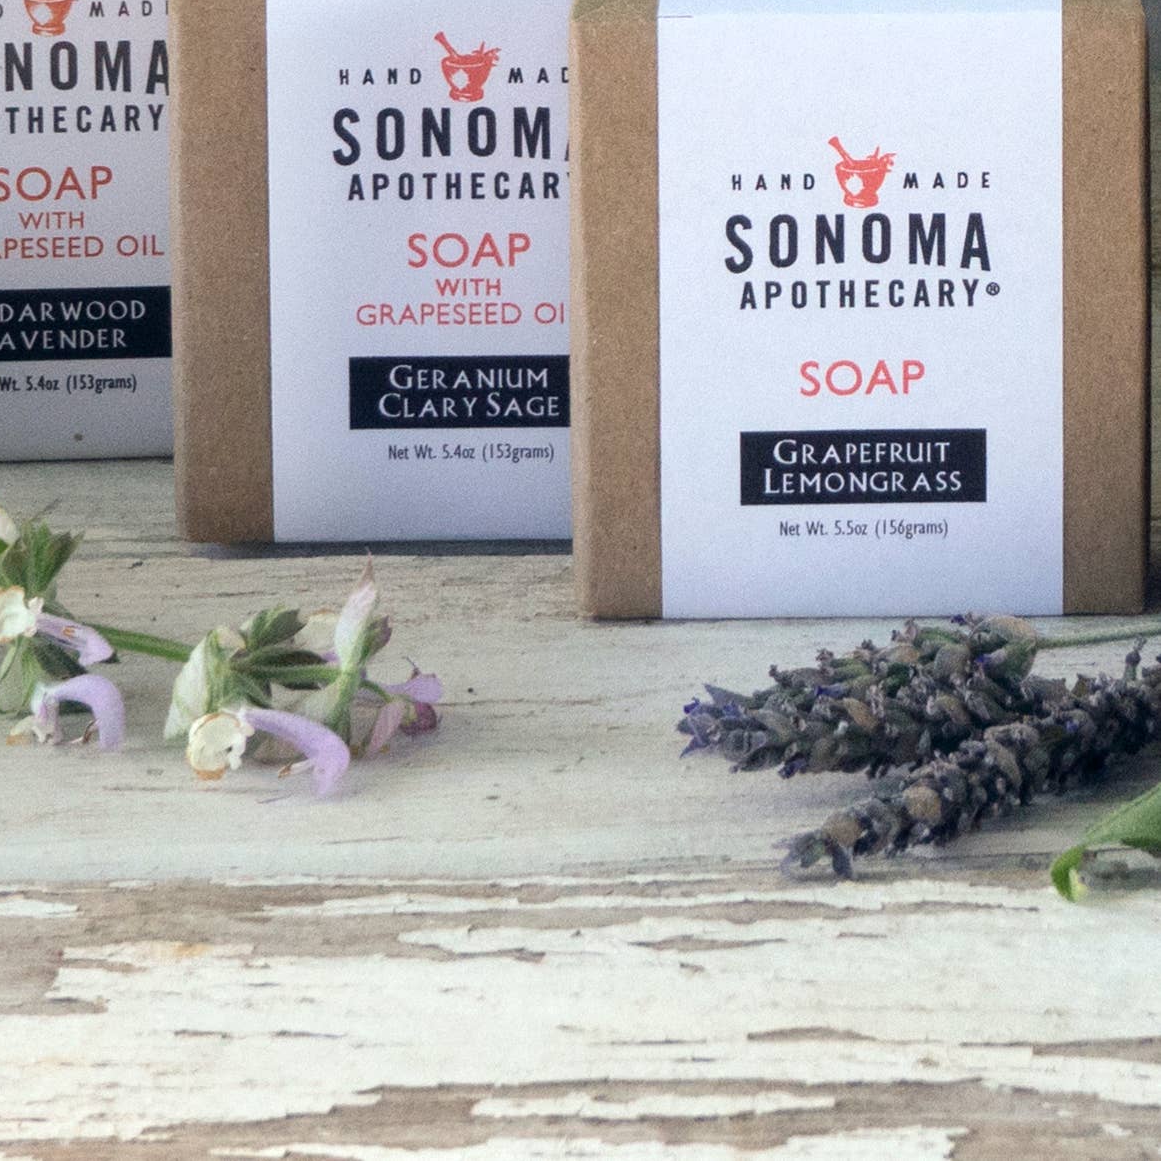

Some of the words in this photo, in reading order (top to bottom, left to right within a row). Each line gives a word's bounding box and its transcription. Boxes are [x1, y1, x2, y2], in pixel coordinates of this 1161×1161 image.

[339, 68, 422, 85] HAND
[508, 67, 569, 84] MAD
[332, 107, 569, 166] SONOM
[348, 172, 569, 200] APOTHECAR
[731, 174, 815, 190] HAND
[903, 171, 990, 189] MADE
[18, 211, 85, 229] WITH
[117, 234, 165, 256] OIL
[407, 232, 531, 268] SOAP
[724, 213, 991, 274] SONOMA
[435, 278, 501, 296] WITH
[356, 303, 522, 326] GRAPESEED
[534, 302, 565, 324] OI
[25, 375, 59, 391] 5.4oz
[66, 374, 137, 393] (153grams)
[799, 360, 925, 397] SOAP
[388, 445, 408, 459] Net
[414, 445, 436, 459] Wt.
[442, 445, 475, 459] 5.4oz
[482, 443, 554, 463] (153grams)
[780, 521, 800, 536] Net
[806, 520, 828, 535] Wt.
[834, 520, 867, 535] 5.5oz
[875, 519, 948, 539] (156grams)
